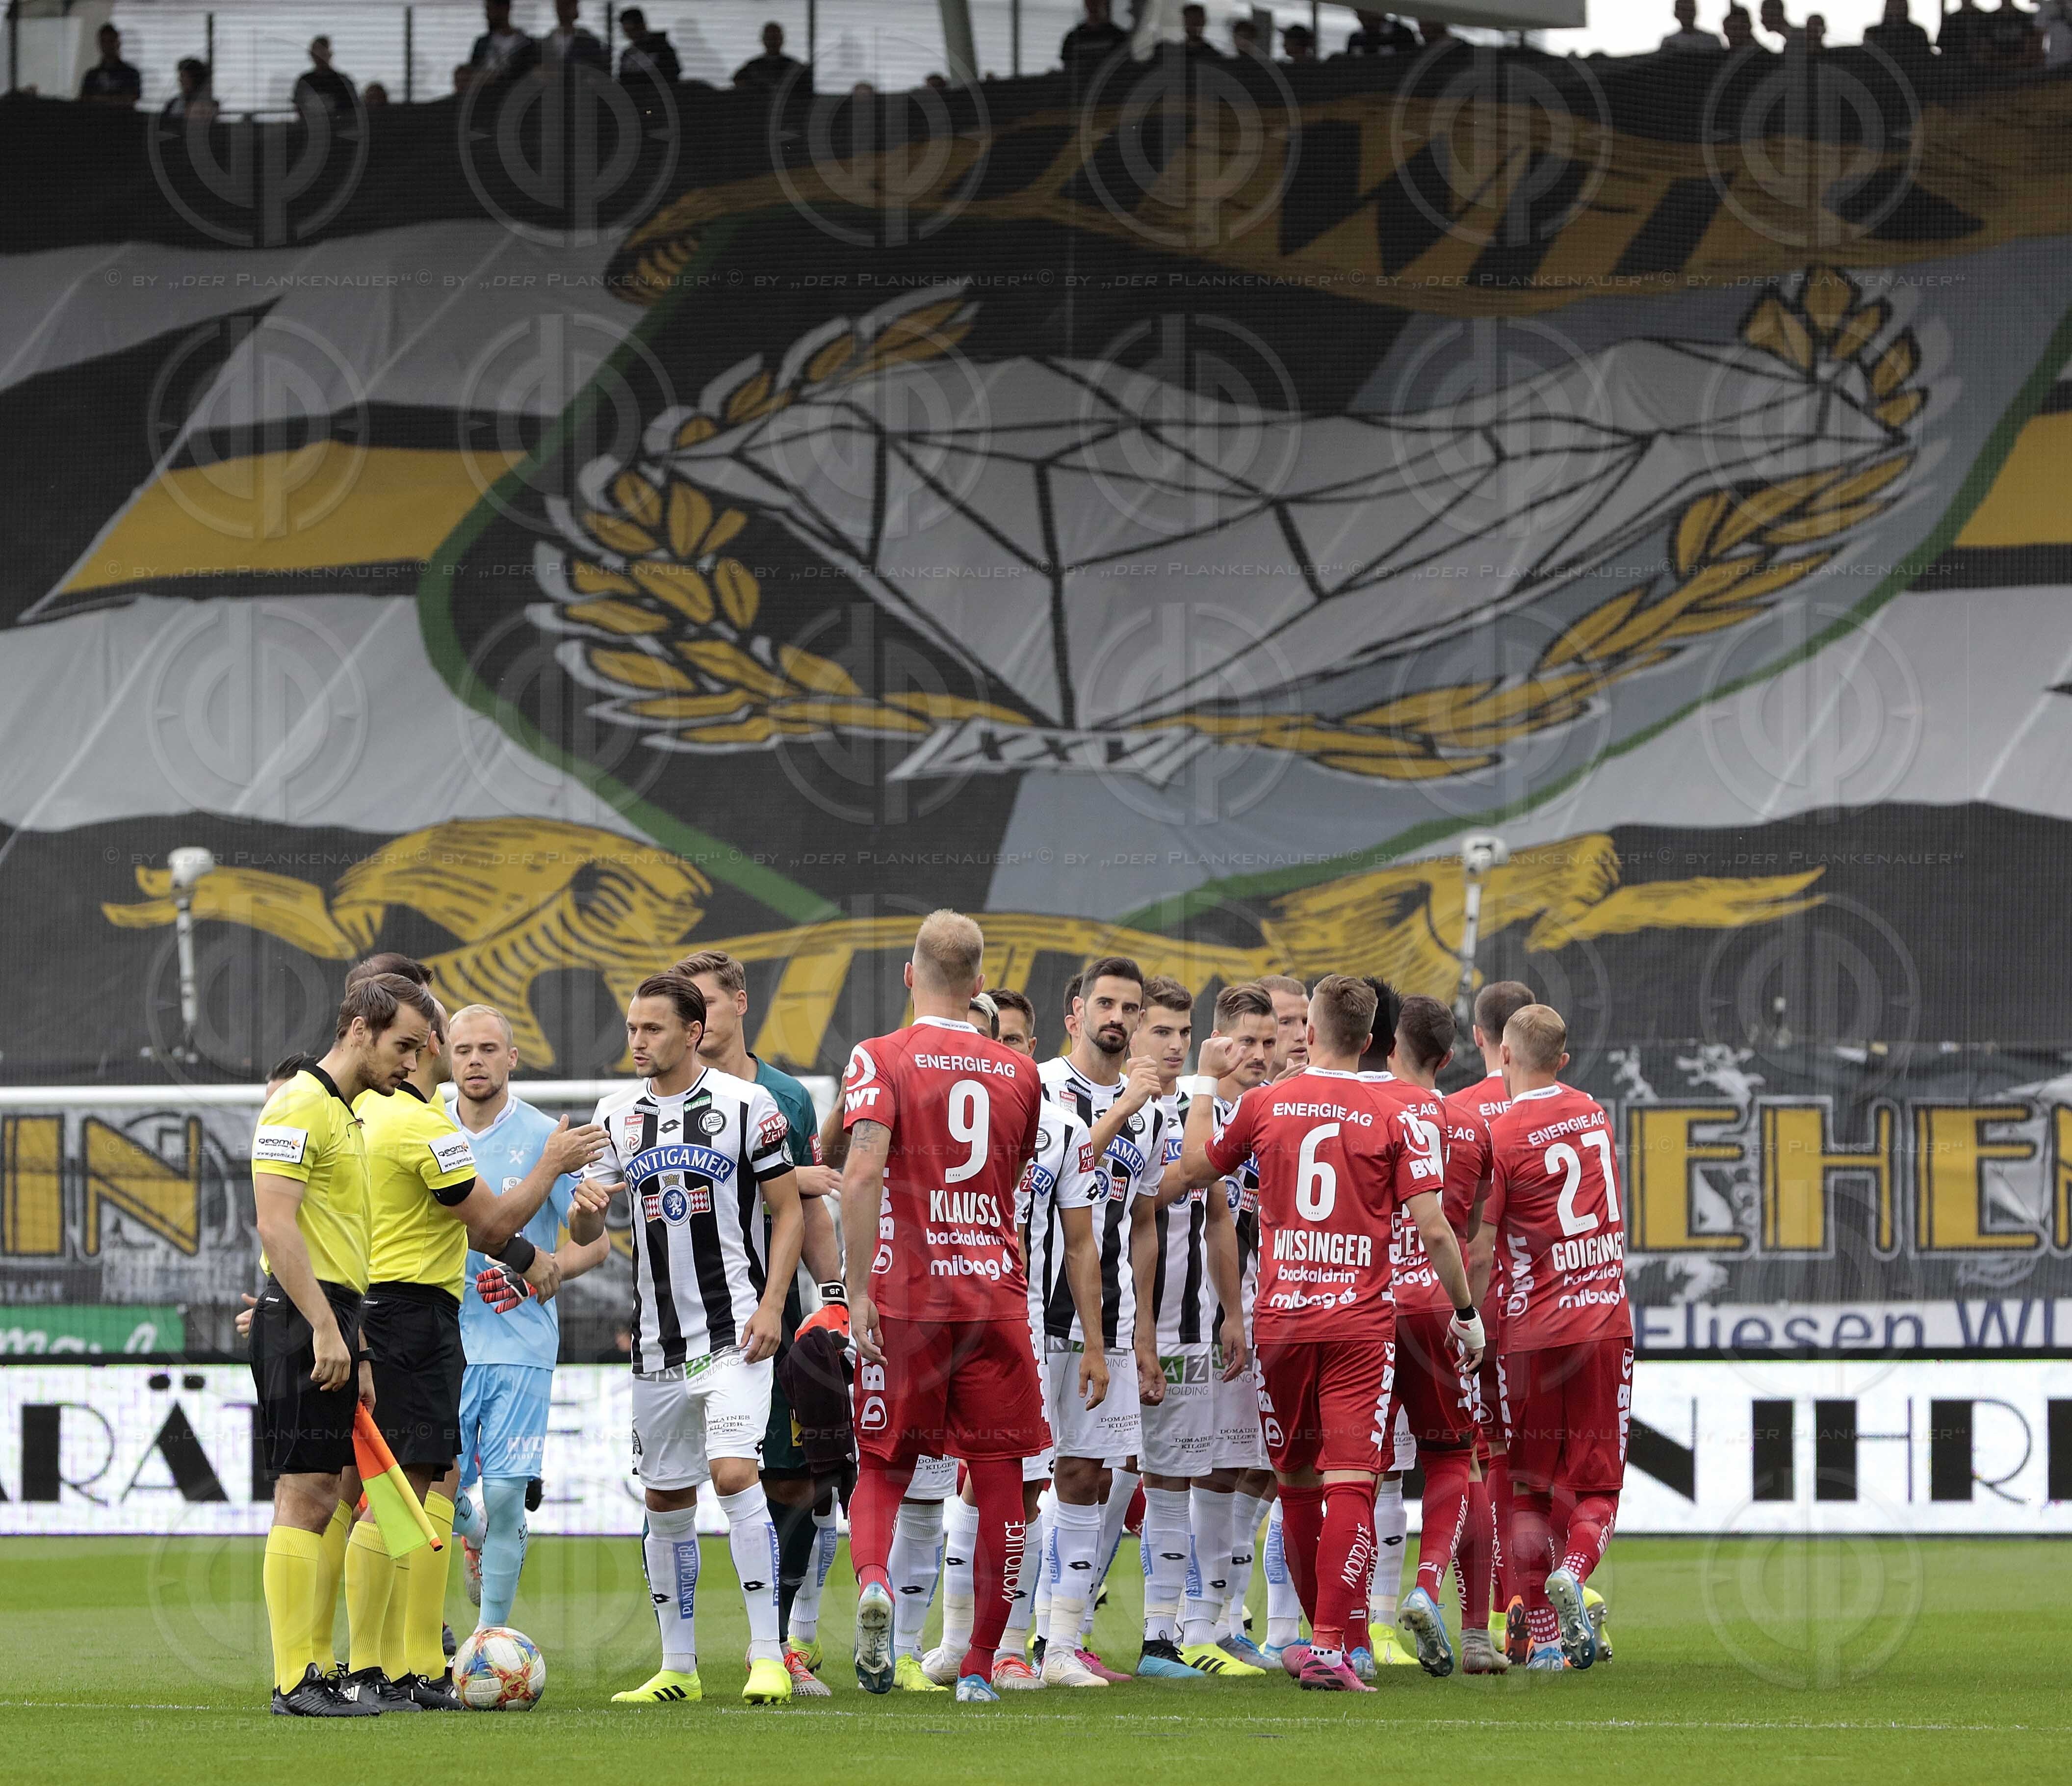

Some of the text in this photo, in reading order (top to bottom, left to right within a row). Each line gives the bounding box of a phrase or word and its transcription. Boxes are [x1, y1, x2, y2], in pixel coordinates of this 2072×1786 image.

[625, 1148, 730, 1189] PUNTIGAMER
[945, 1079, 990, 1183] 9
[1295, 1123, 1341, 1222] 6
[930, 1190, 1001, 1227] KLAUSS
[1544, 1129, 1621, 1237] 27
[1628, 1102, 2072, 1255] EHE
[931, 1255, 1001, 1281] mibag
[678, 1544, 696, 1616] PUNTIGAMER
